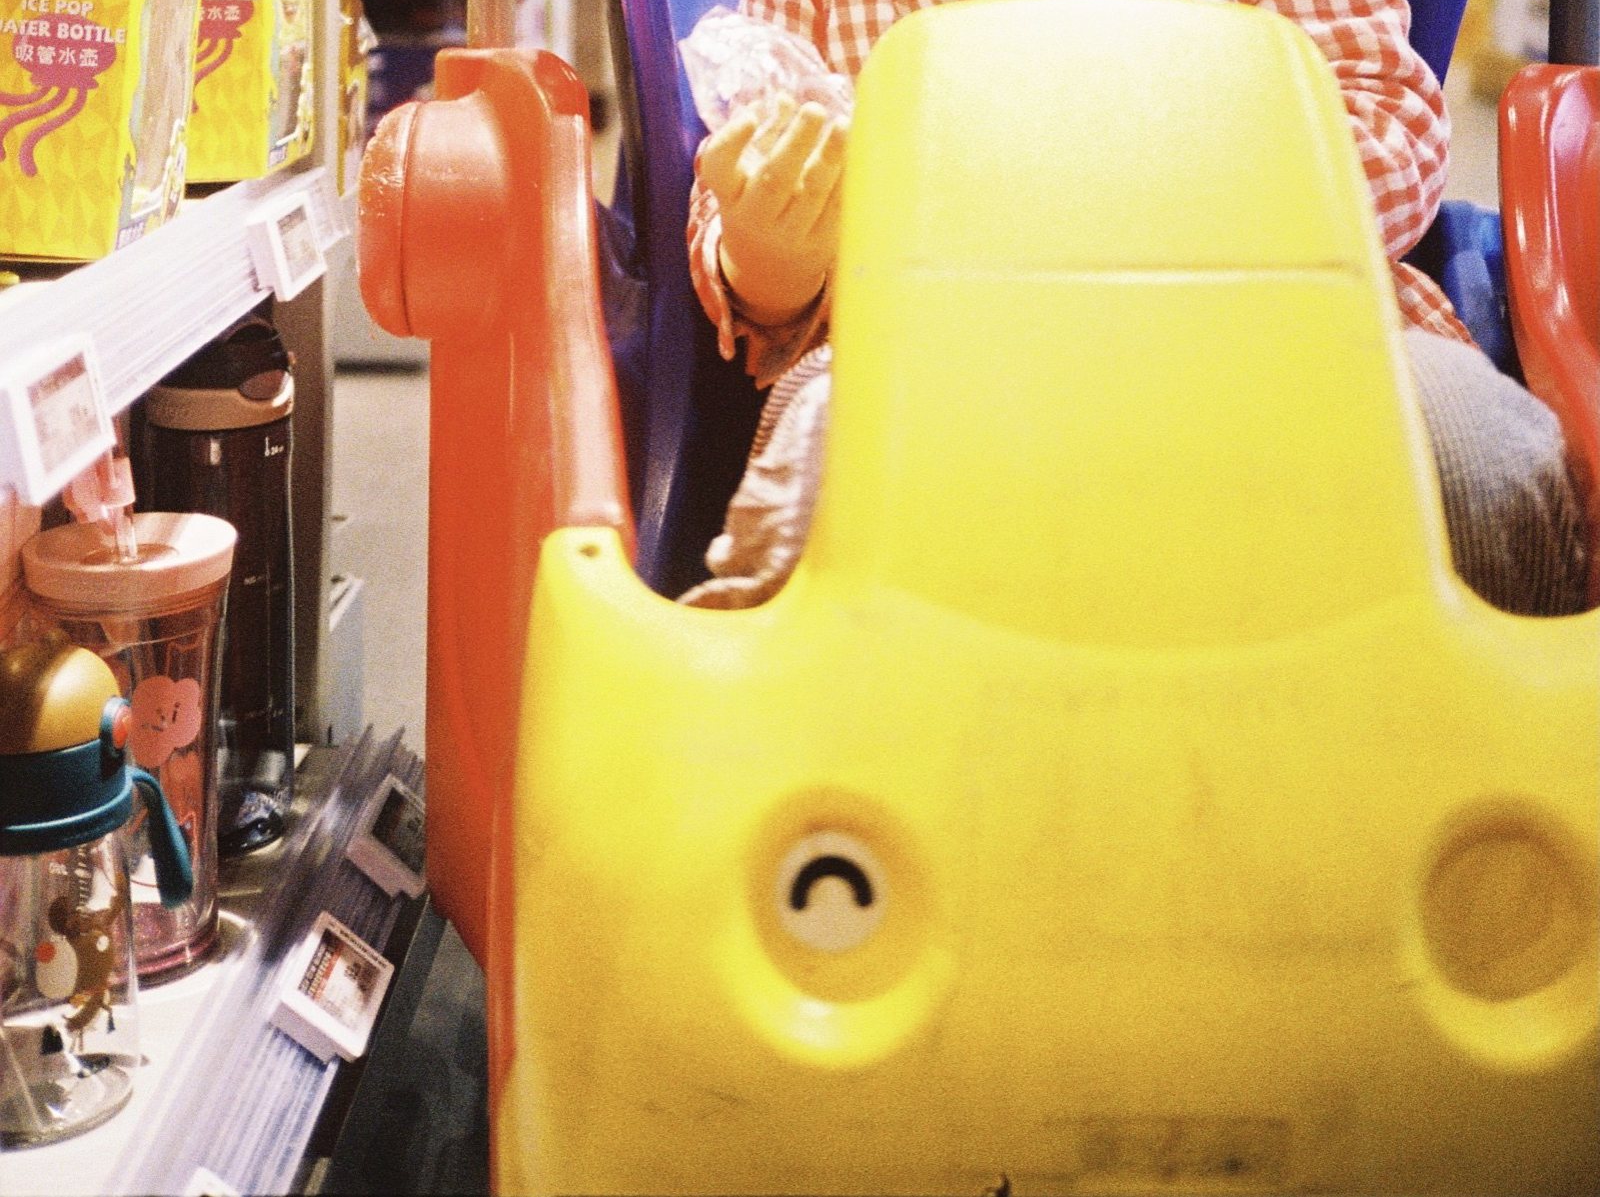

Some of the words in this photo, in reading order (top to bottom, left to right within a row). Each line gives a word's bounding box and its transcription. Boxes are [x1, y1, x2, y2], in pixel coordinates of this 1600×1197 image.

[55, 0, 94, 18] POP
[0, 18, 52, 37] ATER
[57, 22, 126, 44] BOTTLE
